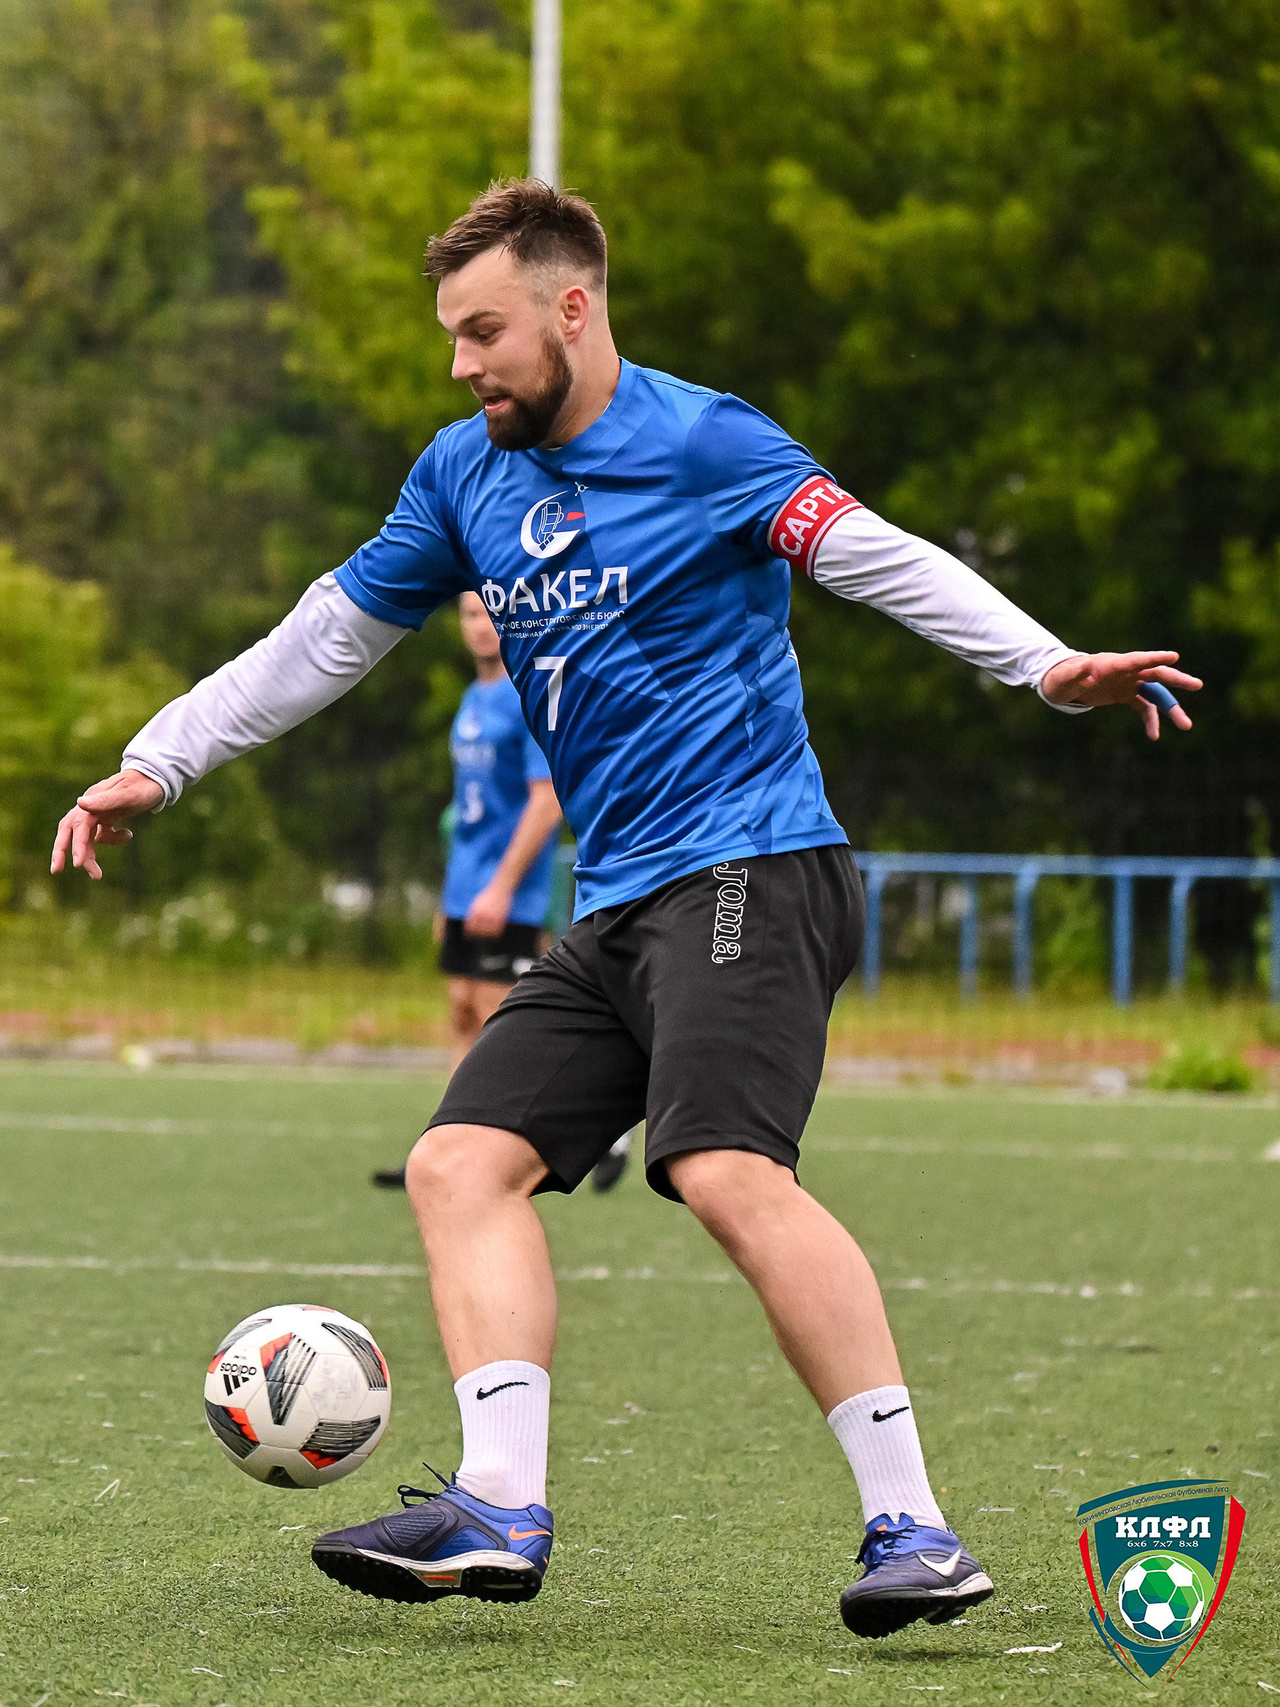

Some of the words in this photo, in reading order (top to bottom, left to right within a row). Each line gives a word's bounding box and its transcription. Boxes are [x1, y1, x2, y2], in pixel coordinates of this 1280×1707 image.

[481, 566, 629, 617] ФАКЕЛ
[533, 656, 568, 732] 7
[712, 862, 748, 964] Joma
[220, 1362, 257, 1376] adidas
